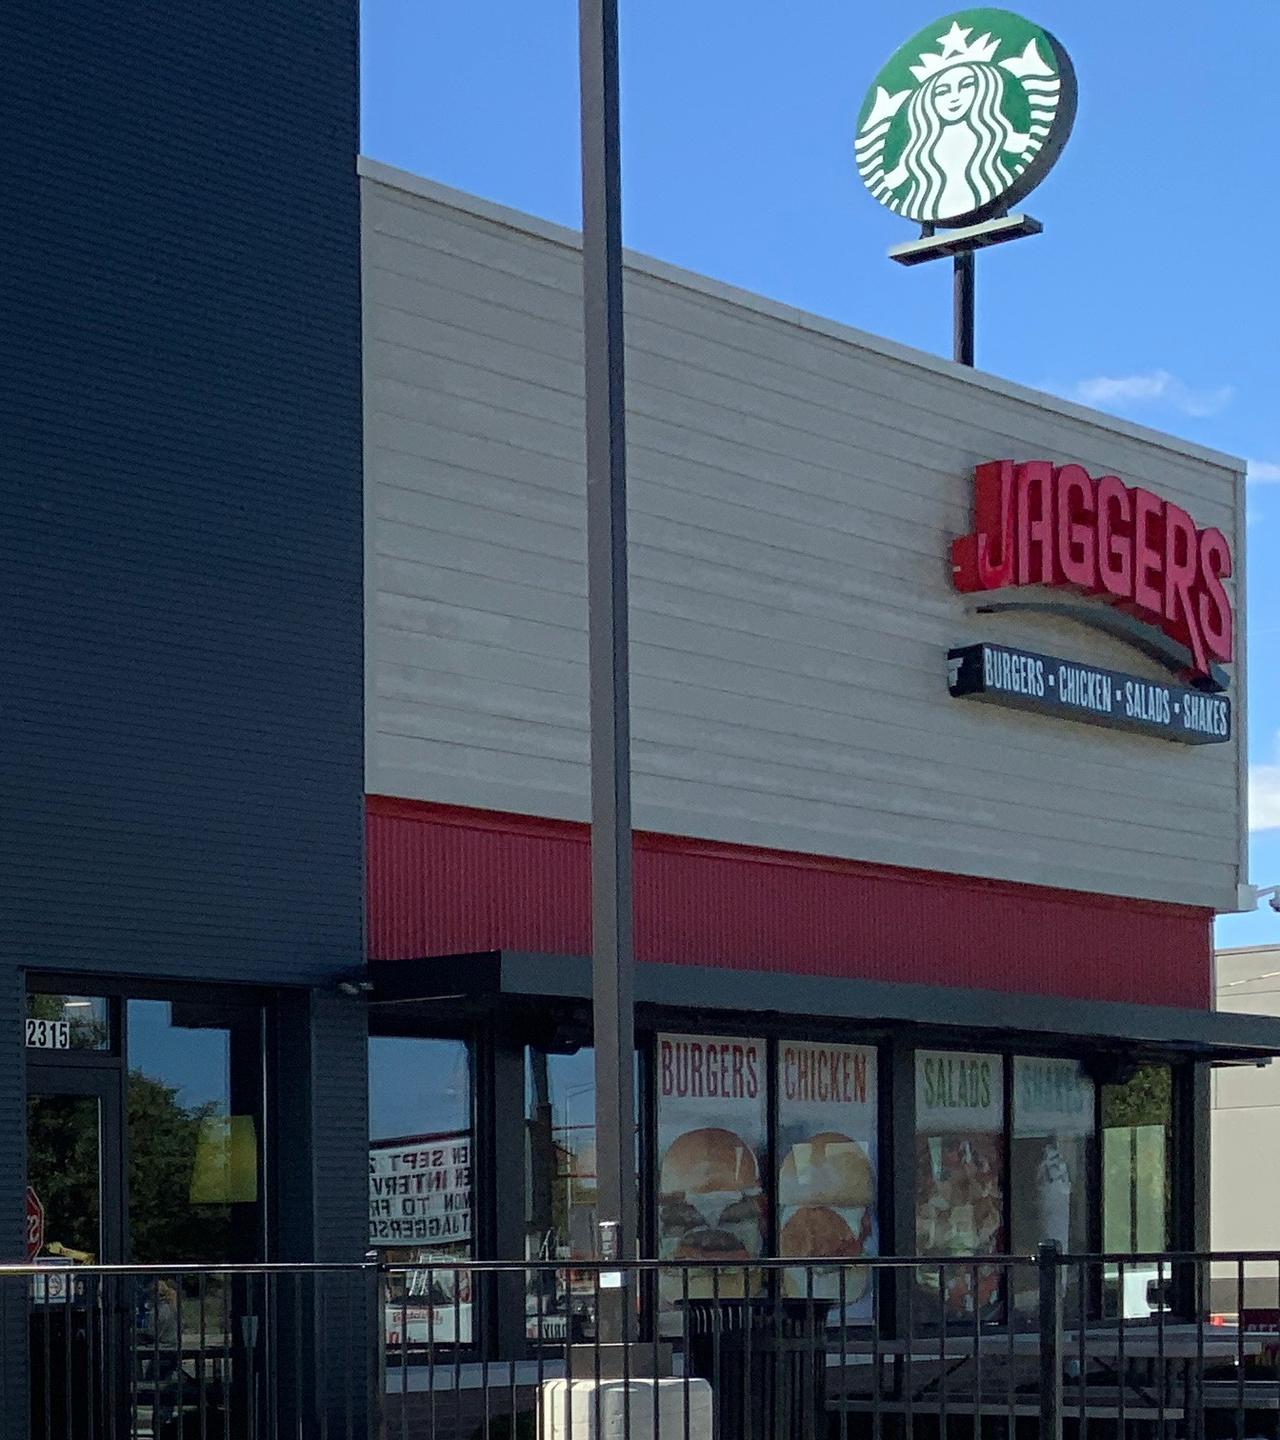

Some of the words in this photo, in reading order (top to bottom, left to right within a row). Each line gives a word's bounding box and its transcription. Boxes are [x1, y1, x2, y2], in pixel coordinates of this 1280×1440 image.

[952, 459, 1232, 675] JAGGERS
[984, 648, 1045, 697] BURGERS
[1059, 666, 1112, 713] CHICKEN
[1126, 681, 1171, 725] SALADS
[1183, 694, 1227, 736] SHAKES
[27, 1020, 68, 1048] 2315
[661, 1040, 759, 1099] BURGERS
[784, 1047, 867, 1103] CHICKEN
[923, 1057, 991, 1109] SALADS
